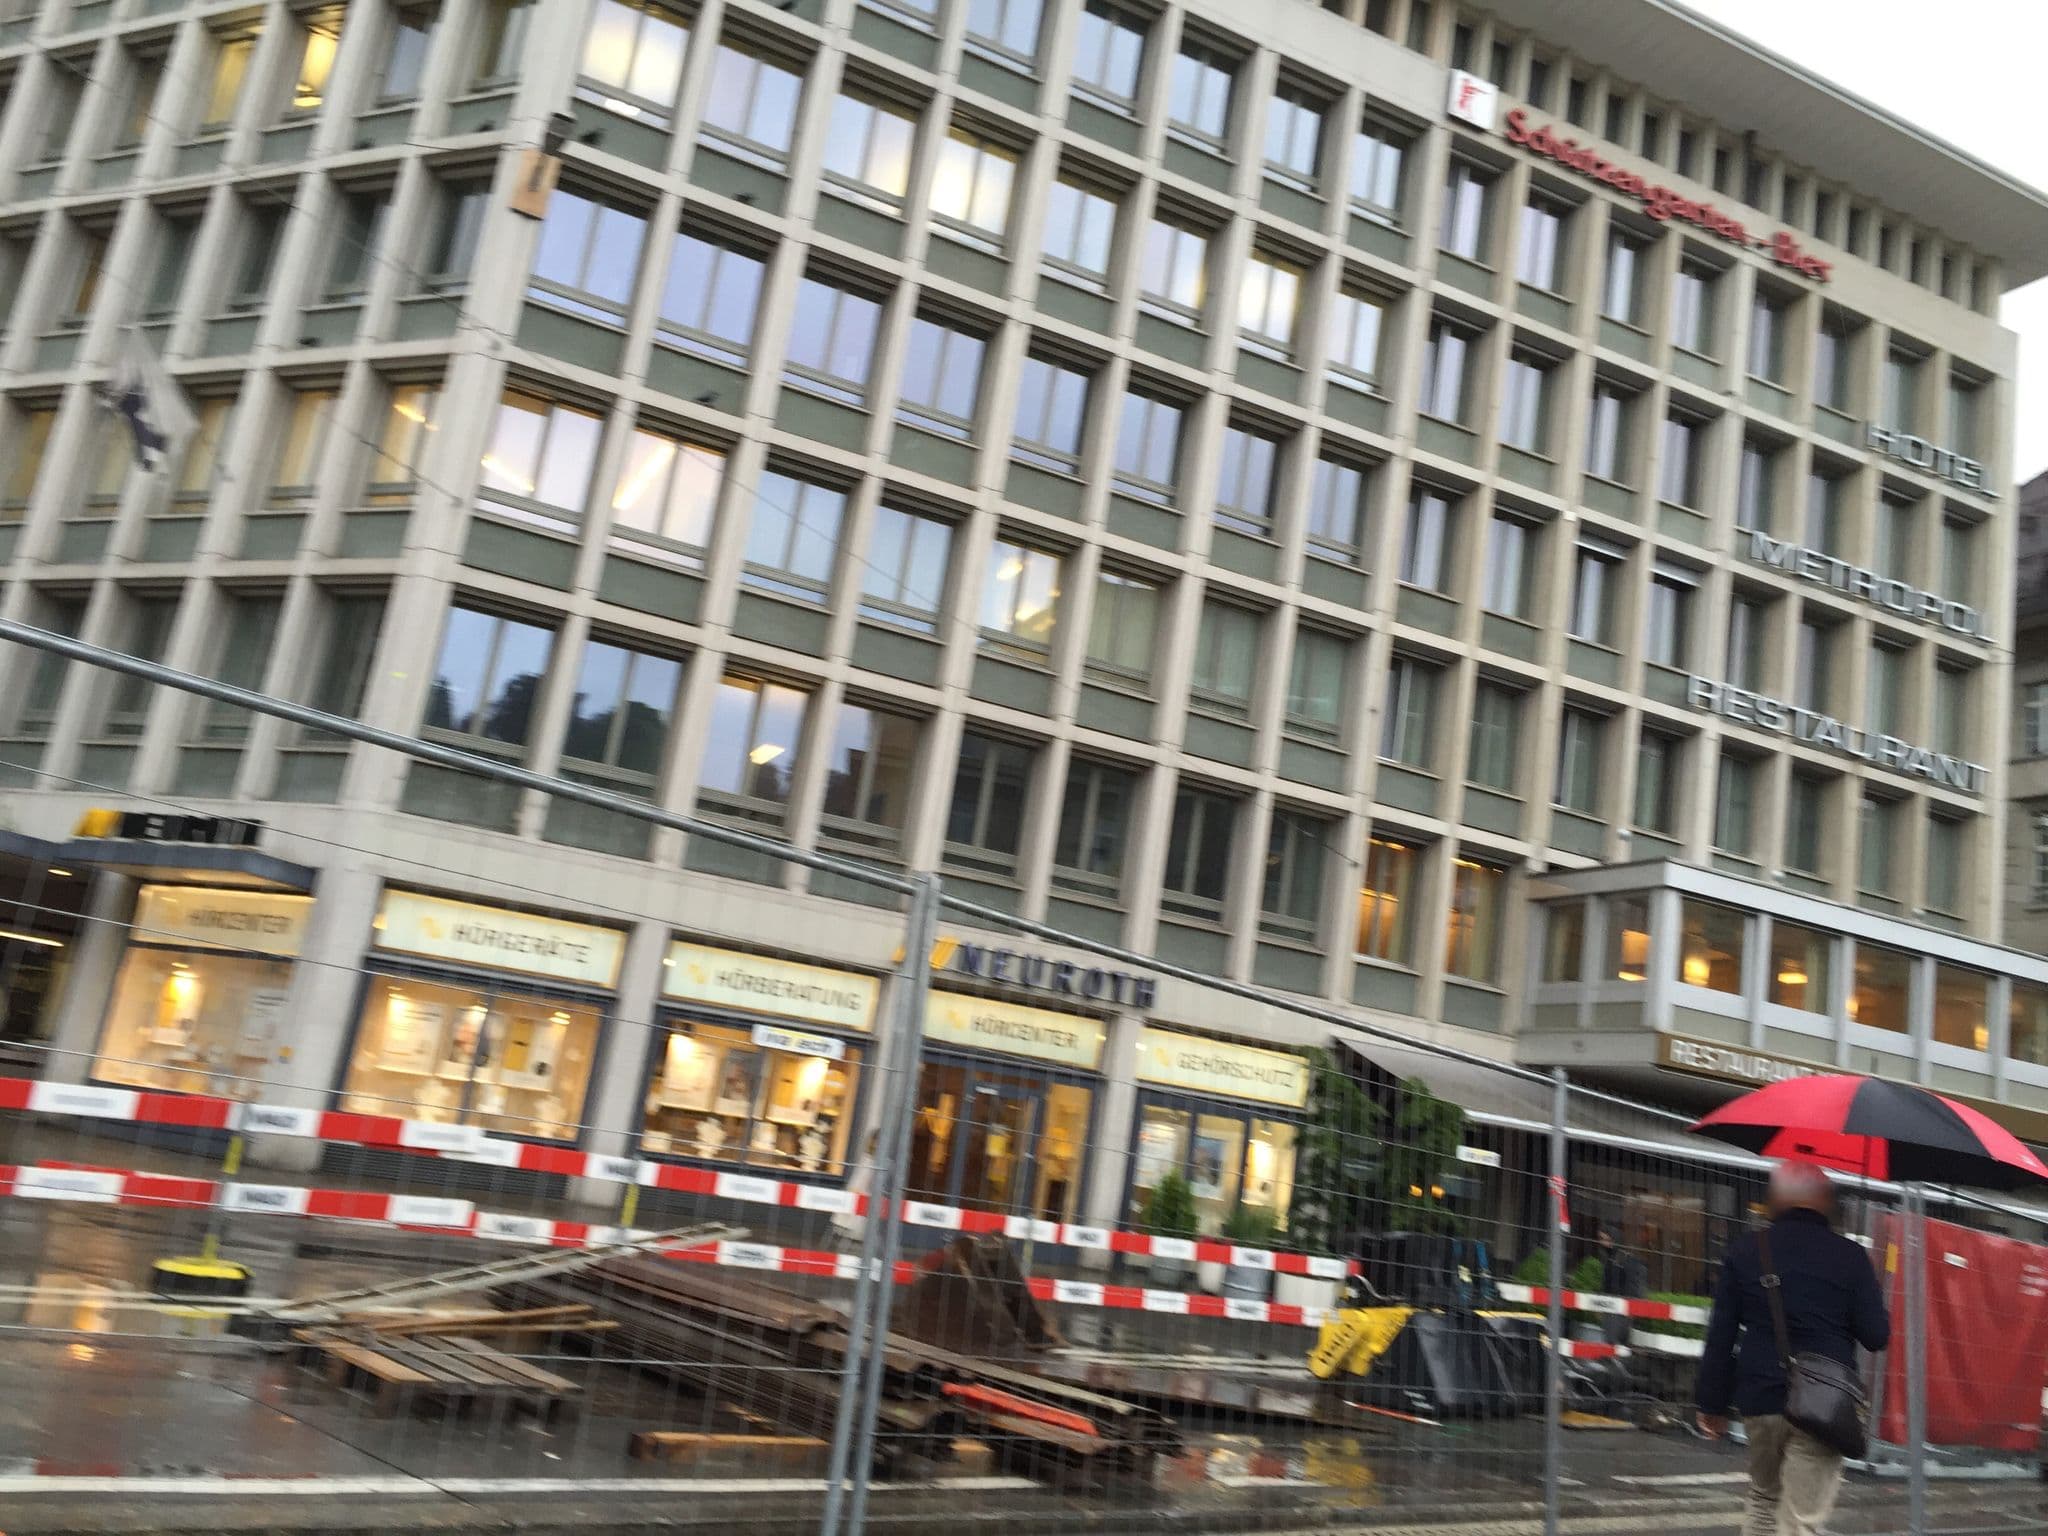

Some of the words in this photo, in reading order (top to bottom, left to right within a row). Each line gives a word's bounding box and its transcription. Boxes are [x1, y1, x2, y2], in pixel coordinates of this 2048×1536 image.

[1865, 420, 2003, 499] HOTEL
[1750, 530, 2001, 645] METROPOL
[1687, 674, 1993, 793] RESTAURANT
[713, 967, 863, 1011] HÖRBERATUNG
[959, 941, 1157, 1009] NEUROTH
[971, 1012, 1080, 1049] HÖRCENTER
[1175, 1050, 1296, 1089] GEHÖRSCHUTZ
